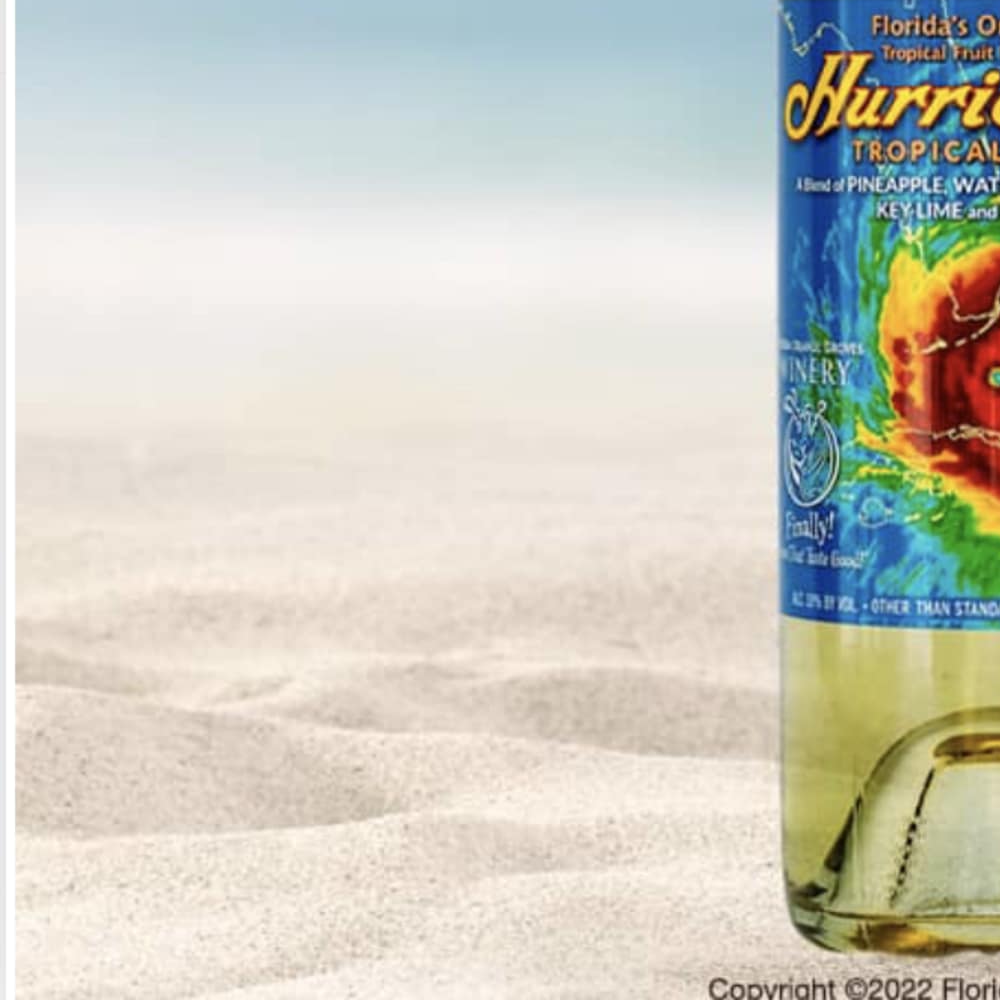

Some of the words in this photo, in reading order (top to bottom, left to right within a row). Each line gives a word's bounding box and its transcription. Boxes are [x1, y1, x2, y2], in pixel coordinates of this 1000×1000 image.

[872, 14, 969, 37] Florida's
[882, 45, 946, 63] Tropical
[953, 45, 994, 62] Fruit
[848, 176, 948, 194] PINEAPPLE,
[876, 202, 913, 219] KEY
[916, 202, 962, 219] LIME
[968, 203, 998, 220] and
[782, 357, 852, 385] INERY
[871, 597, 909, 615] OTHER
[916, 599, 950, 616] THAN
